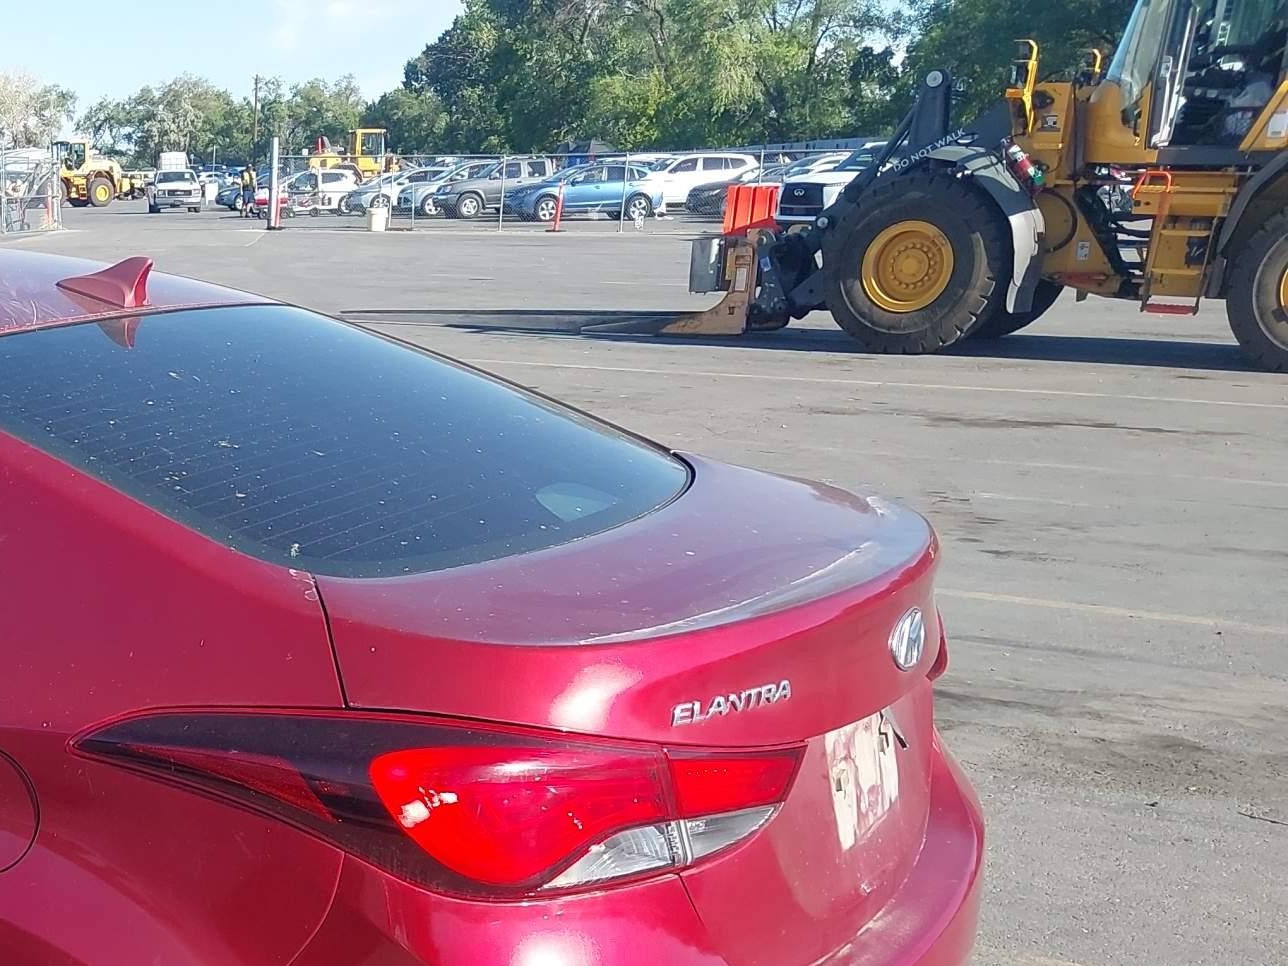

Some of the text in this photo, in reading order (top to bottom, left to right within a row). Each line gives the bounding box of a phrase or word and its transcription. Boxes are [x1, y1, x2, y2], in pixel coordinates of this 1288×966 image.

[893, 127, 966, 173] DO NOT WALK
[672, 679, 792, 727] ELANTRA
